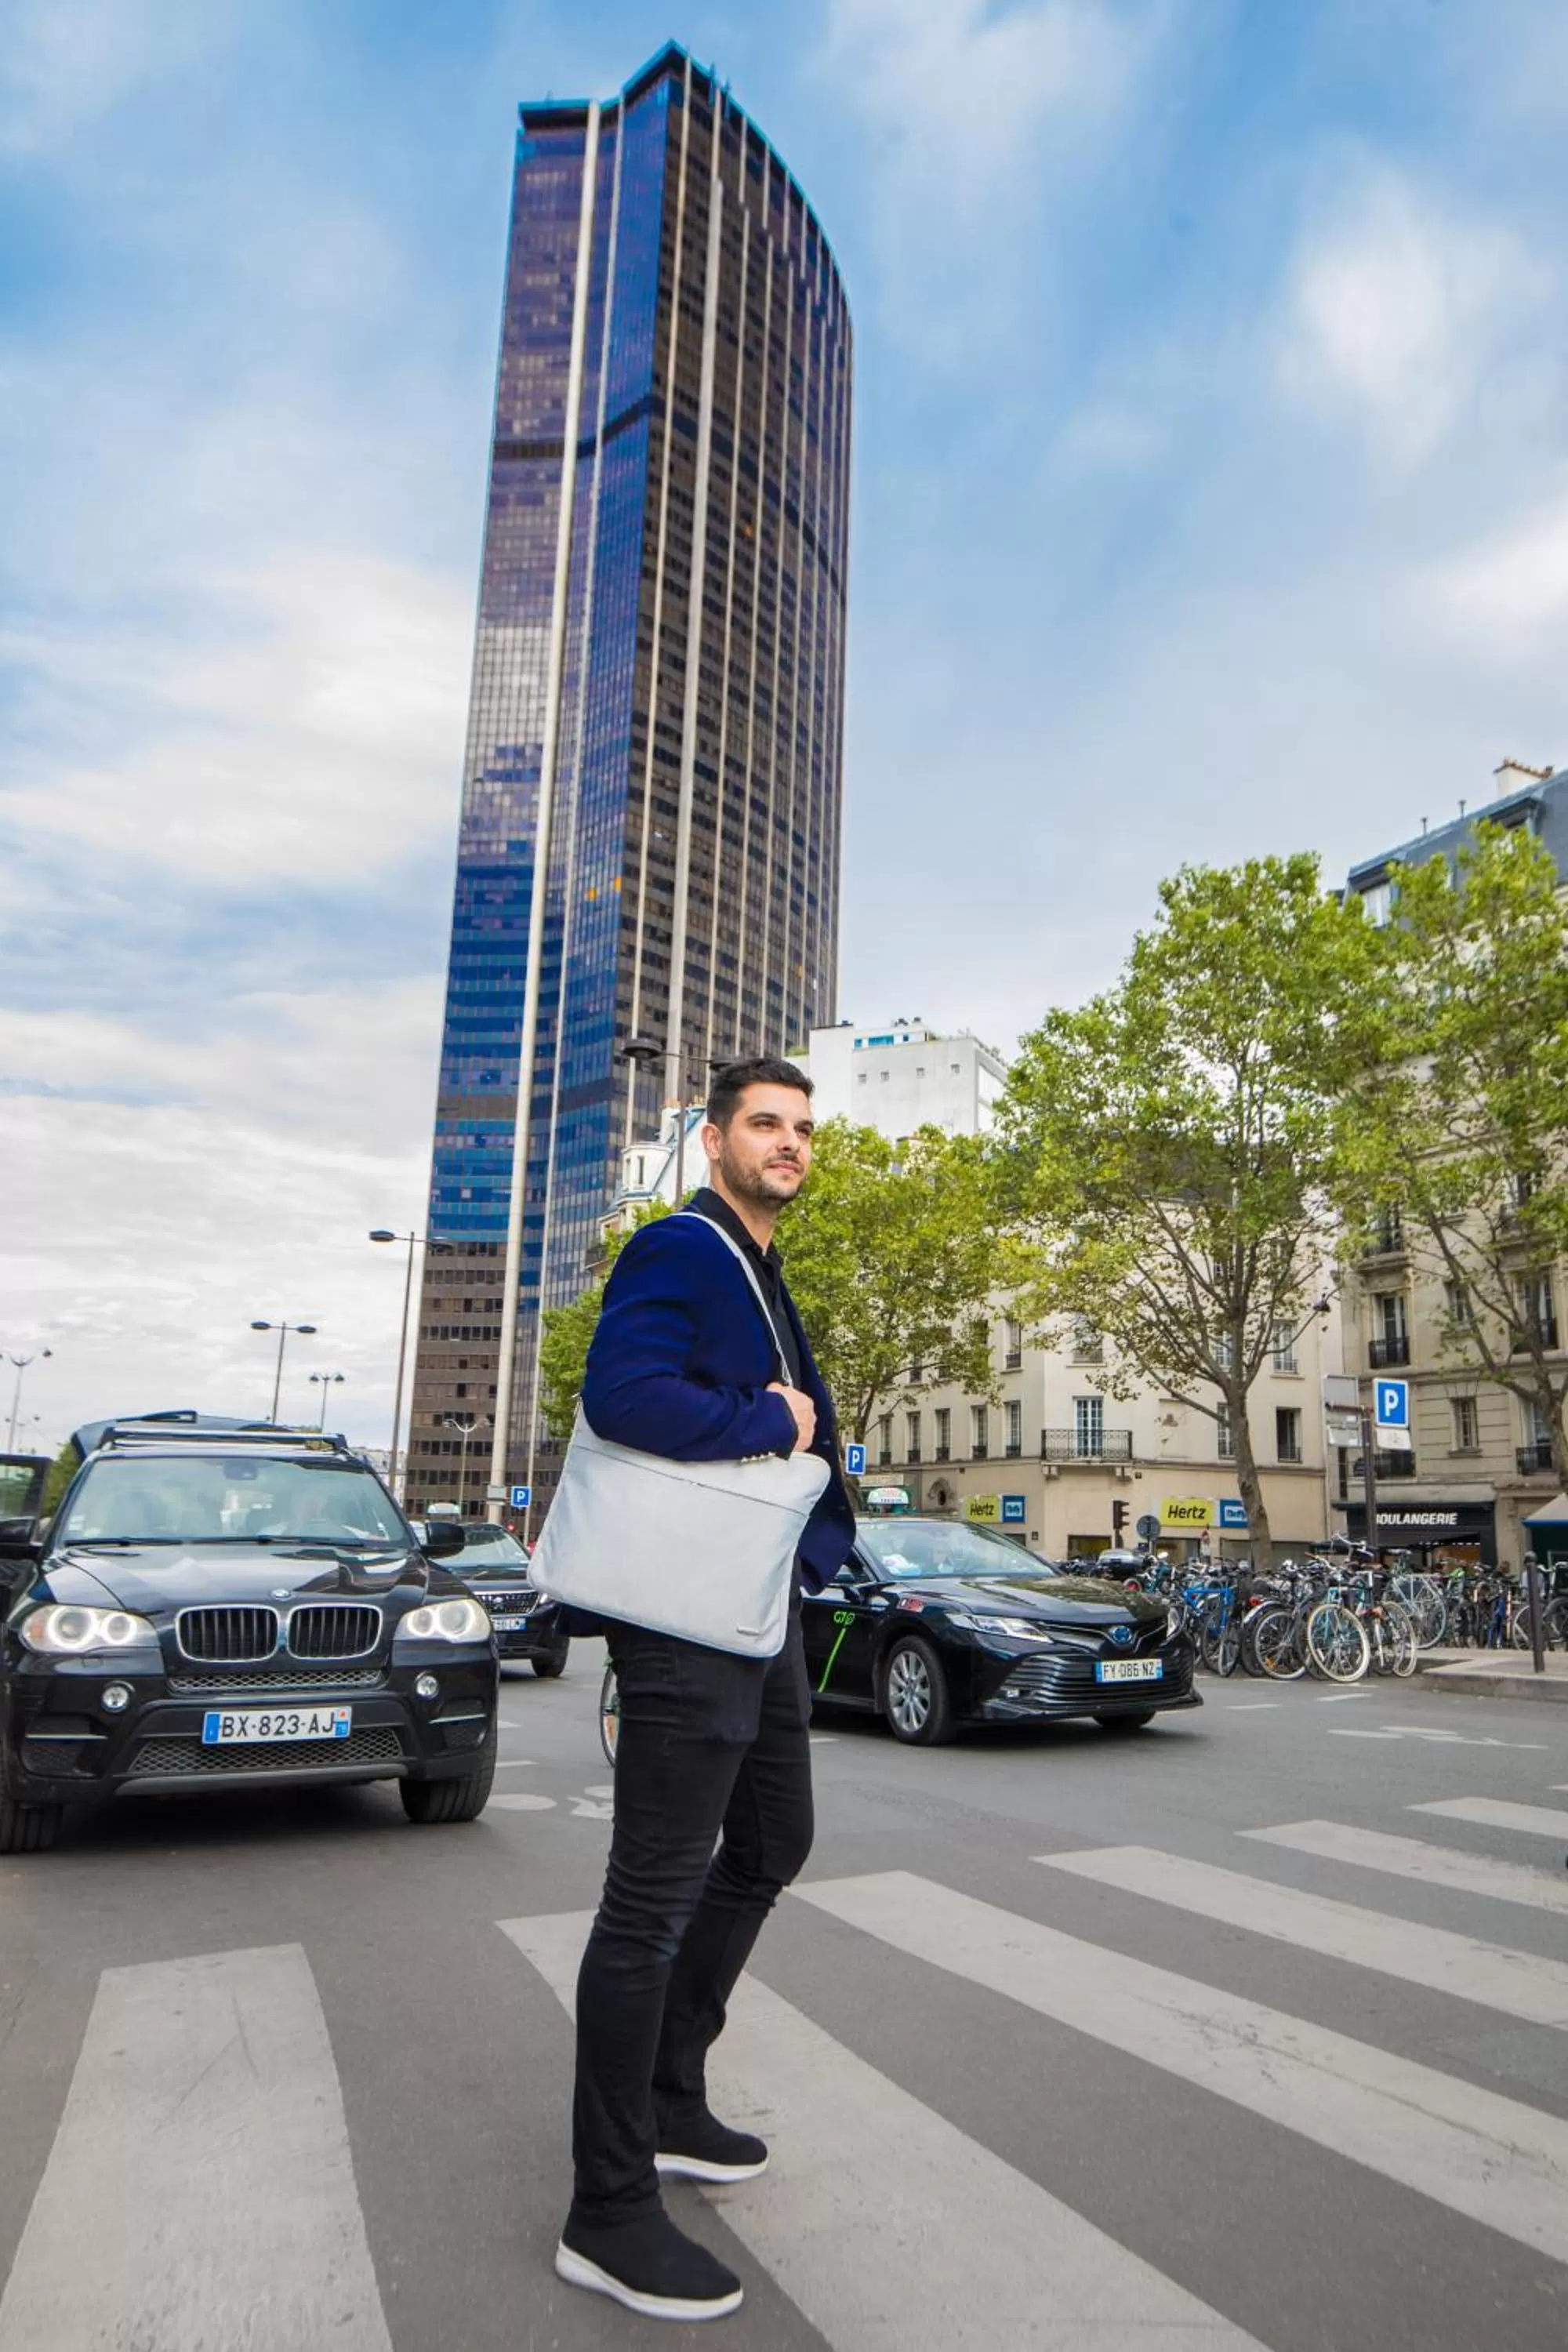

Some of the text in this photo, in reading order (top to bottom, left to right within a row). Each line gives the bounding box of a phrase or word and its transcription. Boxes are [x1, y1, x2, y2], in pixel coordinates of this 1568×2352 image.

[1385, 1388, 1399, 1417] P
[852, 1450, 860, 1468] P
[517, 1490, 525, 1502] P
[970, 1501, 995, 1517] Hertz
[1167, 1504, 1207, 1519] Hertz
